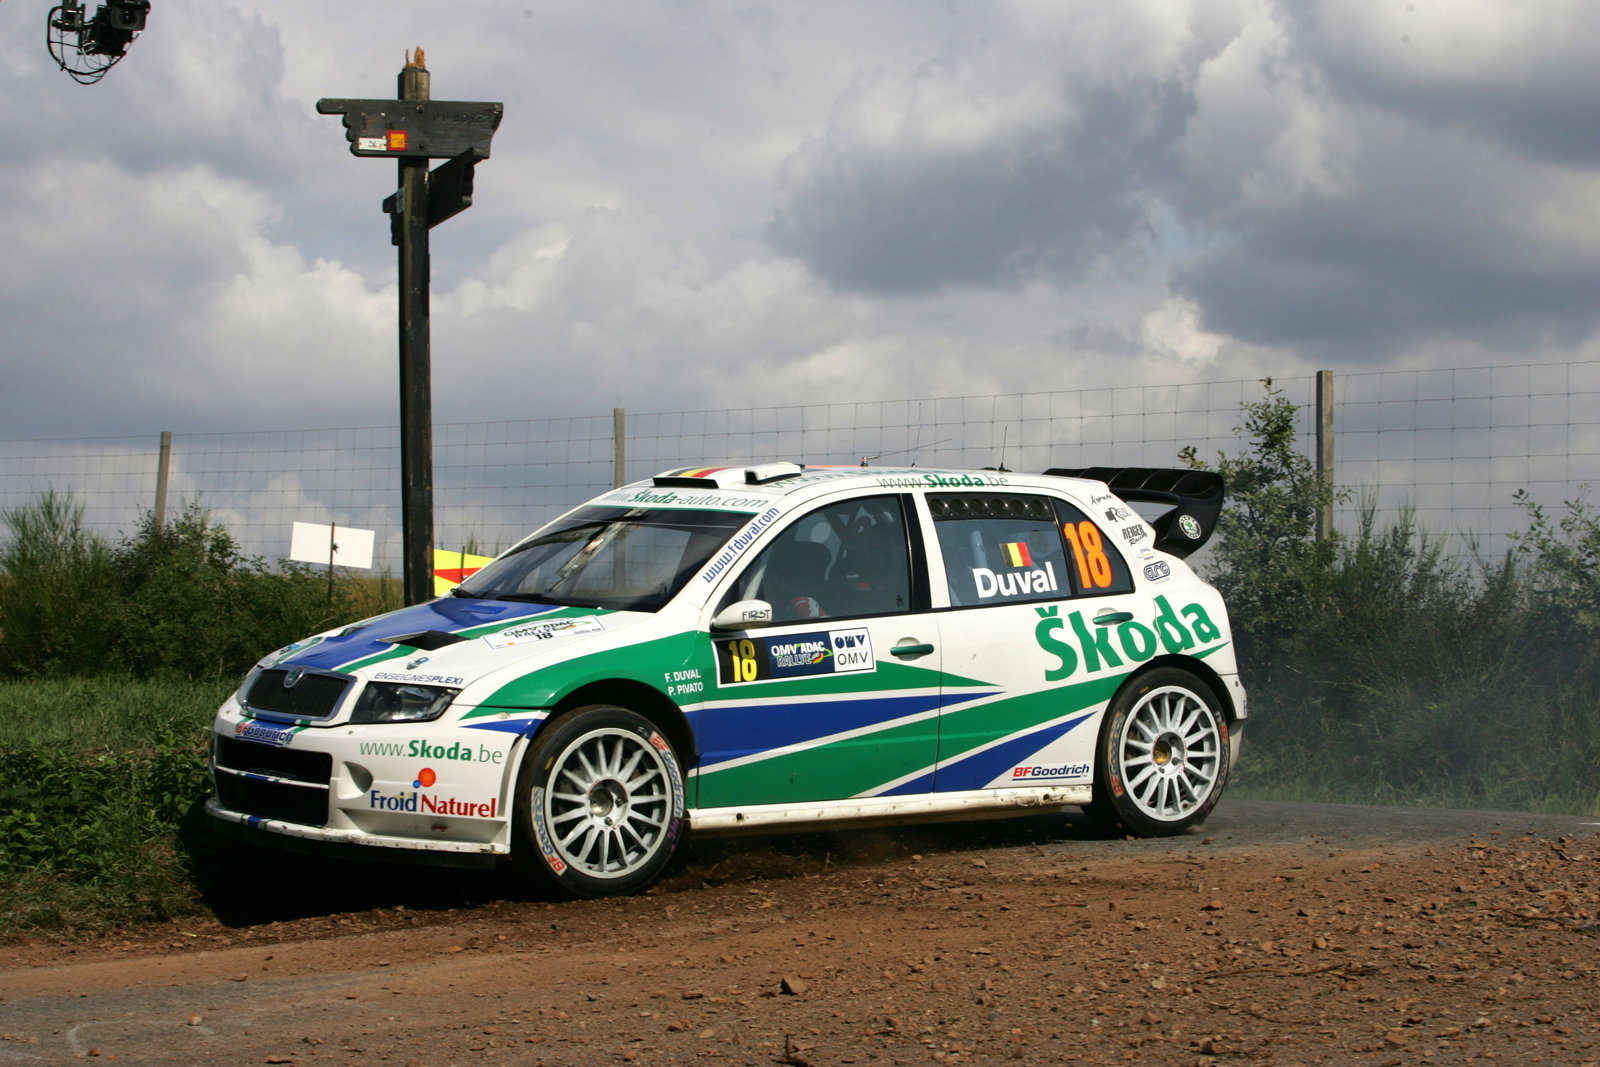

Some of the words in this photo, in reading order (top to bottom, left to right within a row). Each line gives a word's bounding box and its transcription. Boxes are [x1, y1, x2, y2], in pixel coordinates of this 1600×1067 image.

[876, 473, 1009, 488] www.Skoda.be
[702, 507, 780, 583] www.fduval.com
[1064, 520, 1113, 589] 18
[972, 561, 1058, 598] Duval
[742, 609, 771, 623] FIRST
[542, 620, 574, 630] ADAC
[536, 632, 554, 640] 18
[1034, 594, 1222, 682] Škoda
[771, 645, 798, 657] OMV
[800, 641, 825, 654] ADAC
[728, 639, 758, 682] 18
[776, 653, 812, 668] RALLYE
[837, 651, 868, 666] OMV
[374, 672, 464, 685] ENSEIGNESPLEXI
[664, 672, 674, 683] F.
[673, 669, 702, 682] DUVAL
[668, 686, 677, 696] P.
[677, 682, 704, 695] PIVATO
[360, 739, 502, 764] www.Skoda.be
[1013, 764, 1090, 777] BFGoodrich
[370, 790, 417, 812] Froid
[421, 794, 496, 818] Naturel
